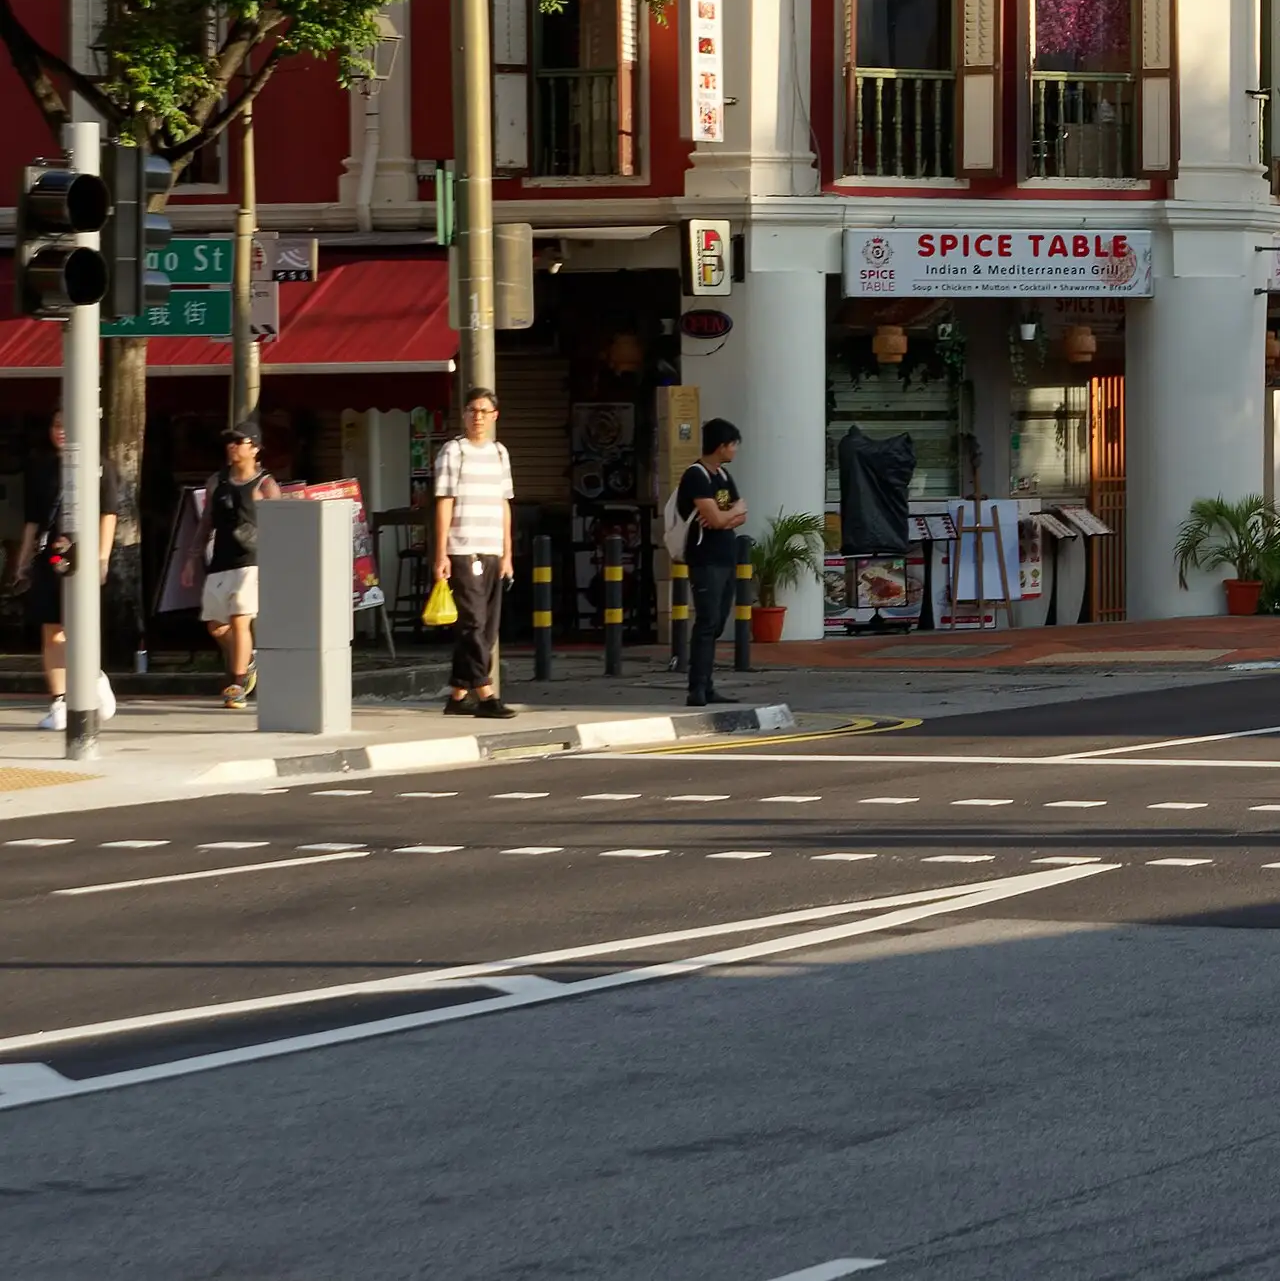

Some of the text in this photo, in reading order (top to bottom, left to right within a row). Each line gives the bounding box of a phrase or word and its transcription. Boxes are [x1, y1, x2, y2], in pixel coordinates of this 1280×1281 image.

[917, 234, 1128, 258] SPICE TABLE
[193, 244, 224, 271] St
[860, 269, 896, 280] SPICE
[926, 264, 1119, 275] Indian & Mediterranean Grill
[861, 282, 896, 292] TABLE
[912, 283, 1132, 293] Soup Chicken Mutton Cocktail Shawarma Bread
